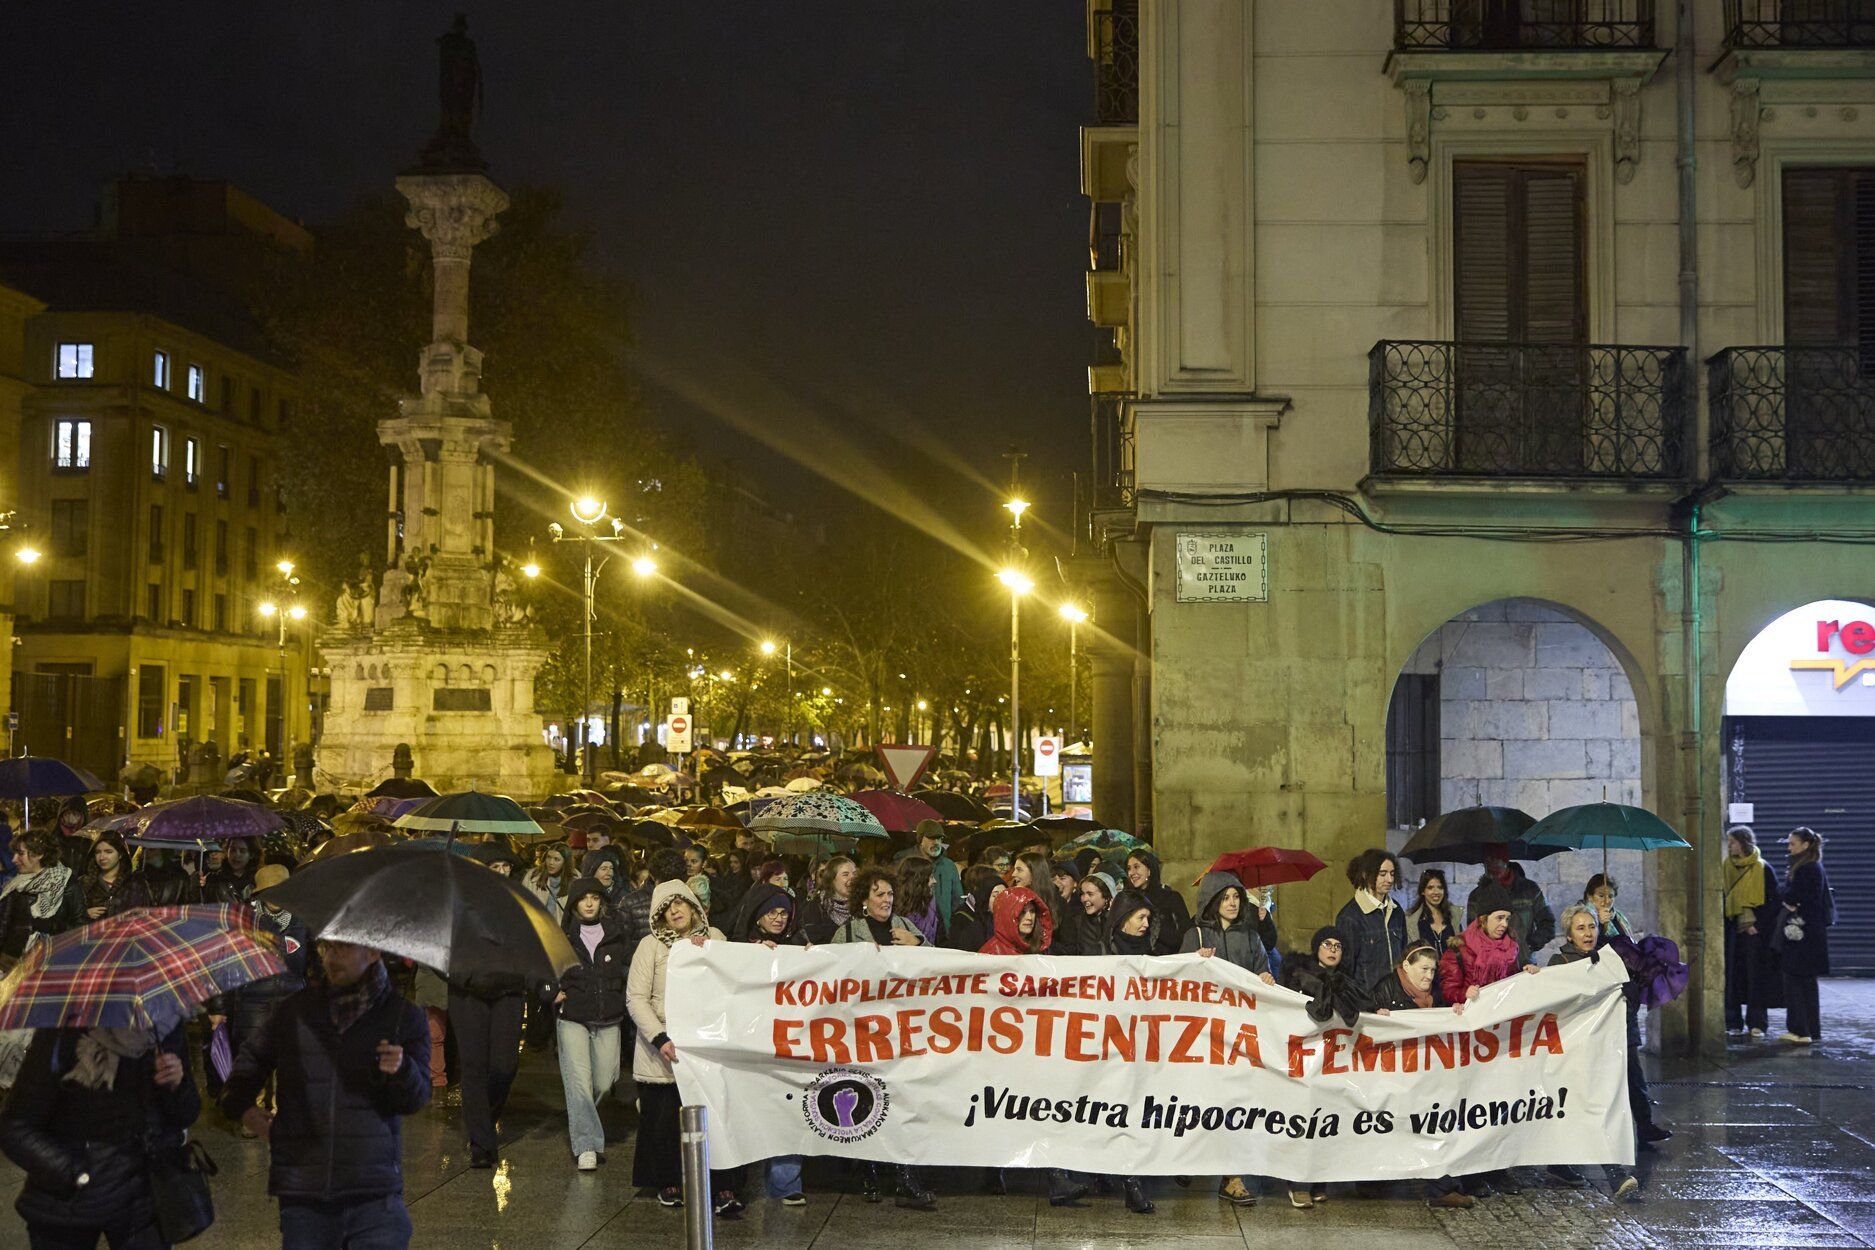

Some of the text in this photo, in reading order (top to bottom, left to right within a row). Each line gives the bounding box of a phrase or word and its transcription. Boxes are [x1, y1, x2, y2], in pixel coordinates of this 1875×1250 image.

[1209, 544, 1234, 553] PLAZA
[1191, 556, 1253, 565] DEL CASTILLO
[1196, 573, 1247, 582] GAZTELUKO
[1208, 585, 1236, 594] PLAZA
[774, 973, 1258, 1010] KONPLIZITATE SAREEN AURREAN
[772, 1007, 1564, 1078] ERRESISTENTZIA FEMINISTA
[964, 1086, 1569, 1139] ¡Vuestra hipocresía es violencia!
